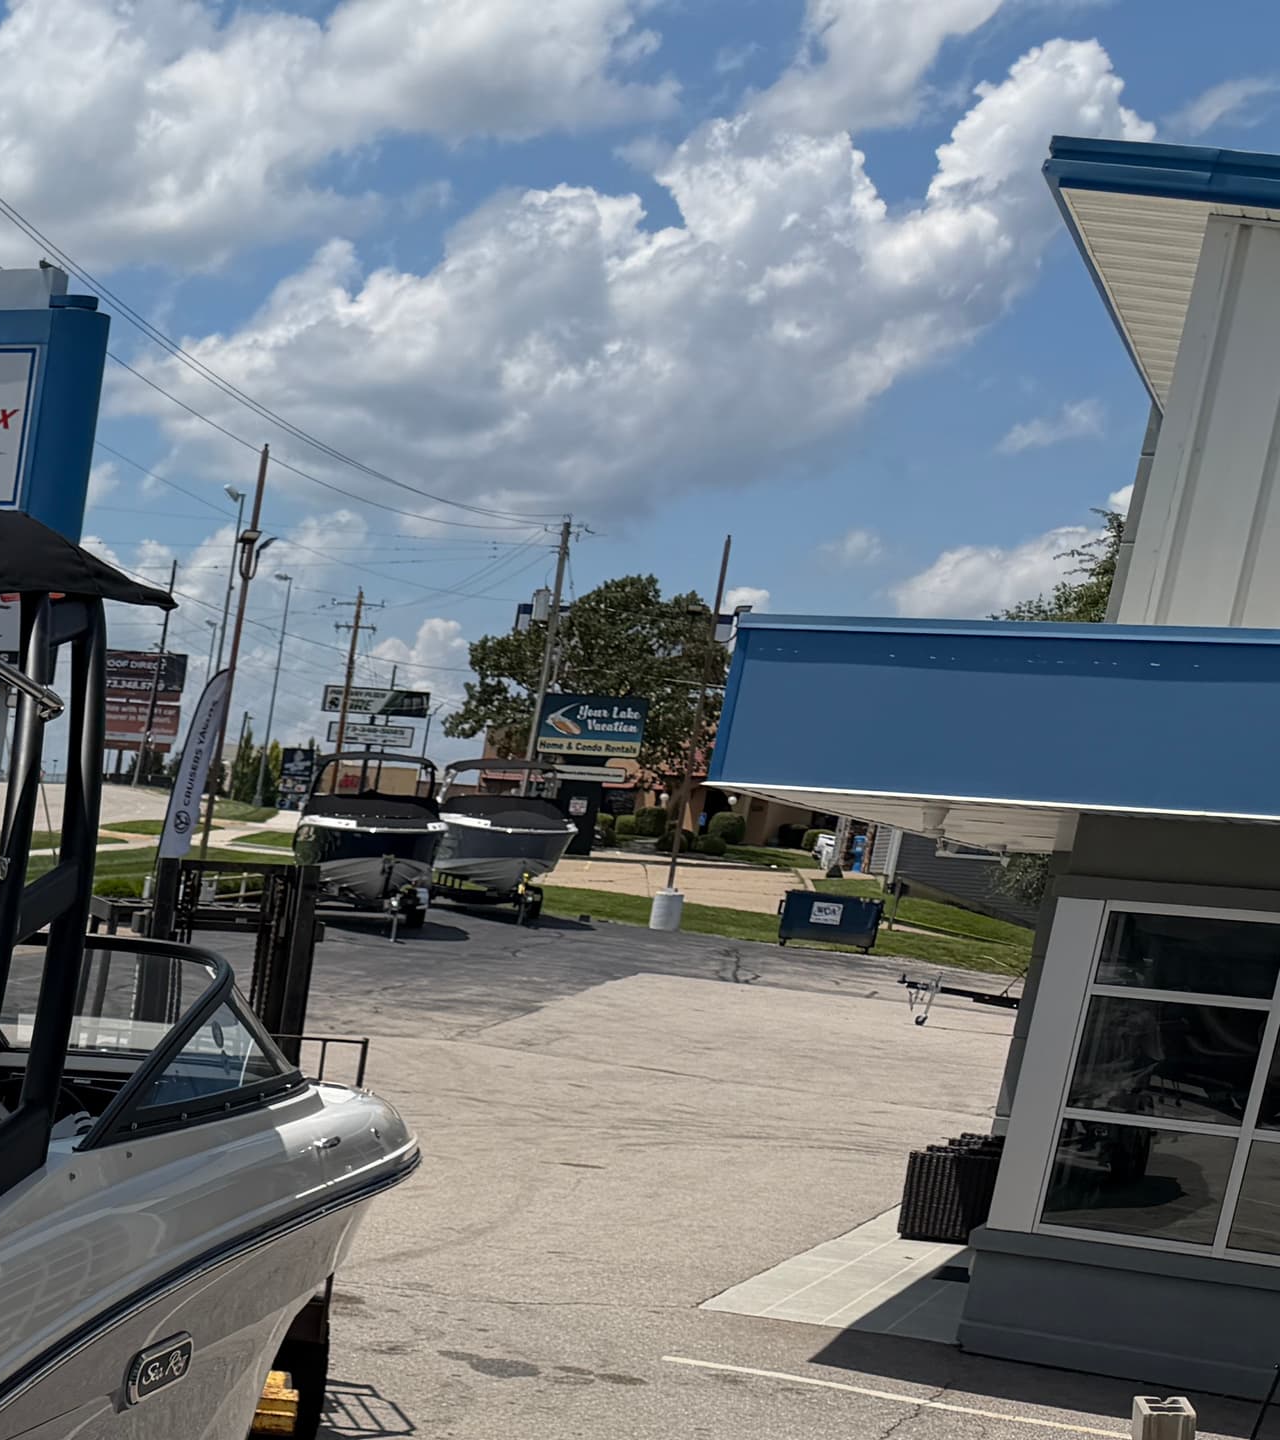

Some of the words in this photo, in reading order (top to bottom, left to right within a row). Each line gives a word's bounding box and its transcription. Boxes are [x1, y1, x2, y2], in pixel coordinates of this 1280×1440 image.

[577, 704, 609, 720] Your
[612, 706, 641, 719] Lake
[587, 719, 638, 733] Vacation
[540, 741, 564, 750] Home
[575, 743, 602, 752] Condo
[604, 744, 637, 754] Rentals
[142, 1362, 164, 1385] Sea
[164, 1350, 189, 1377] Ray
